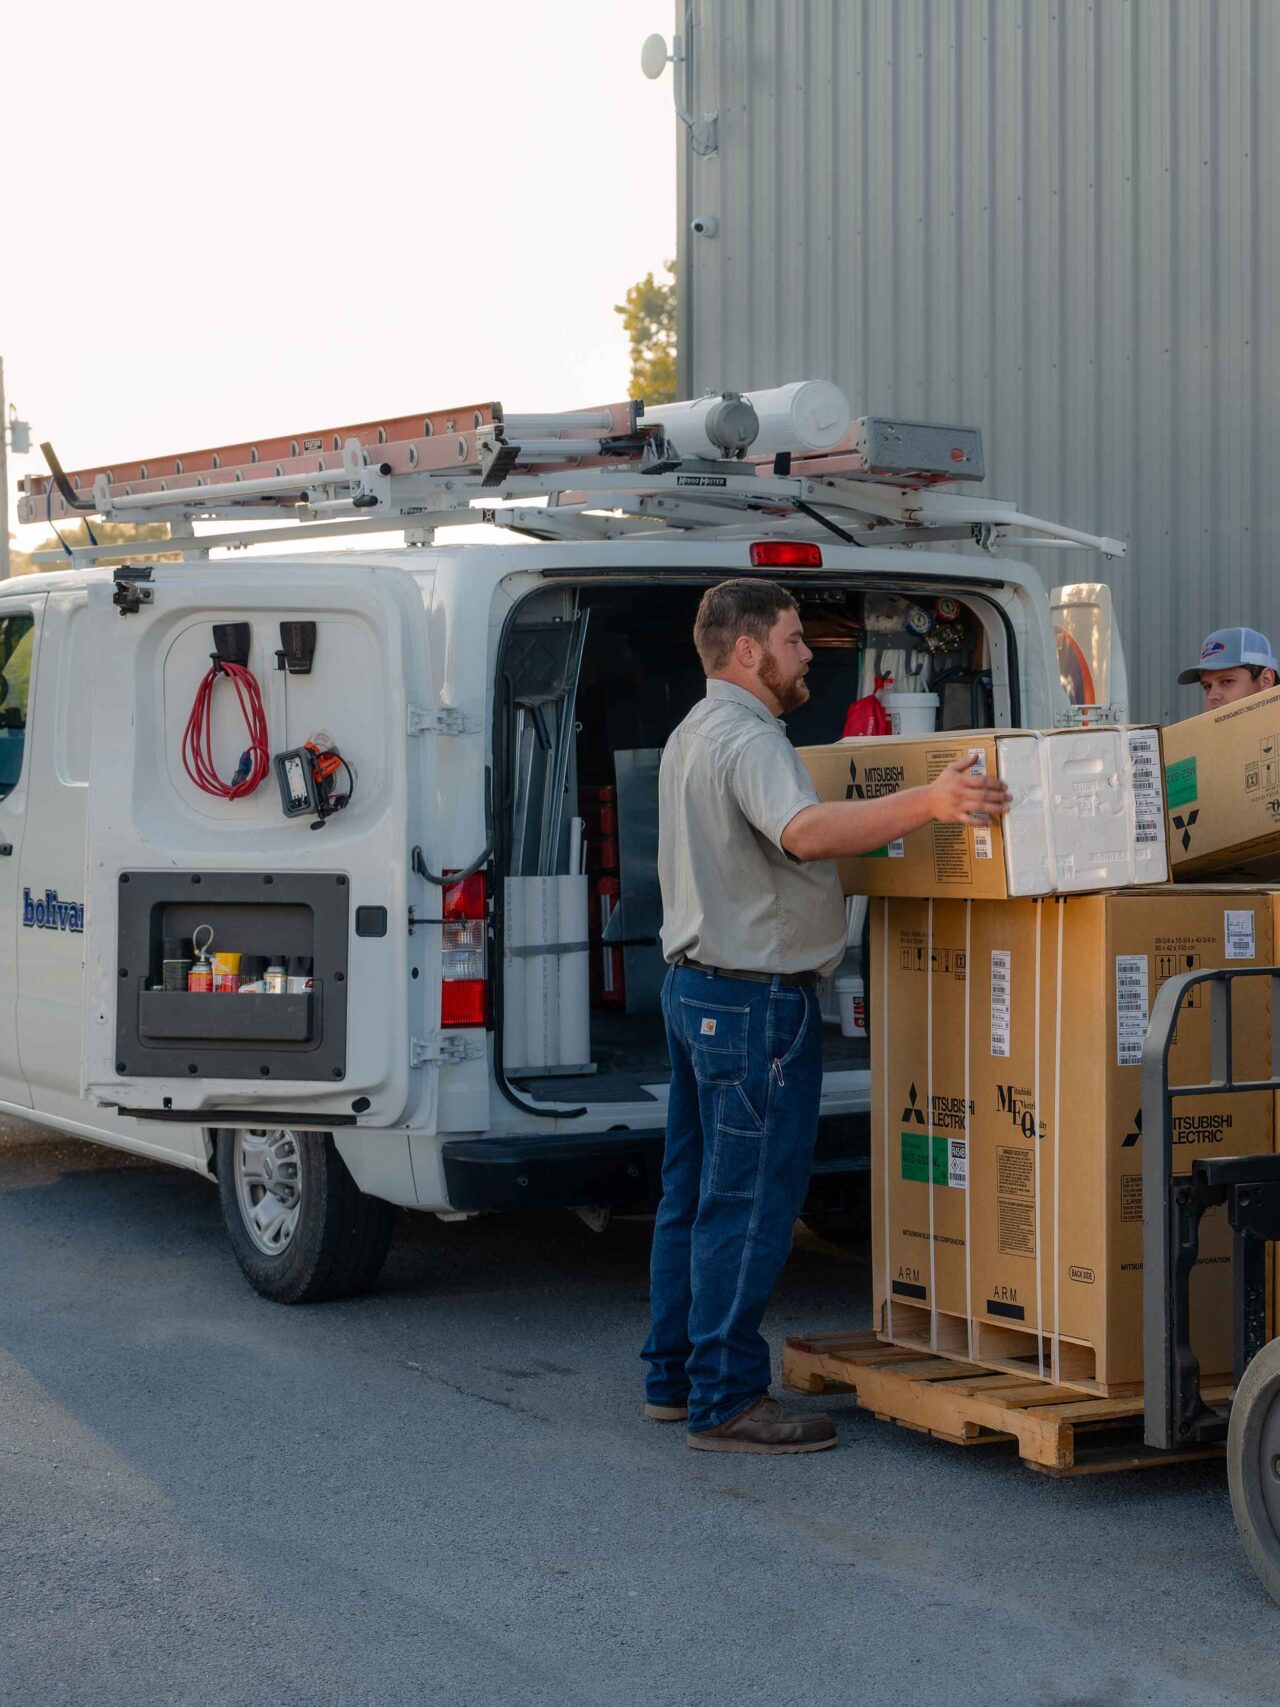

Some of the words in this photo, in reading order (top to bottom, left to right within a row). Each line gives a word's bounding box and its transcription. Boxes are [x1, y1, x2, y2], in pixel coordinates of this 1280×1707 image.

[864, 766, 905, 783] MITSUBISHI
[1172, 1114, 1232, 1130] ITSUBISHI
[1172, 1130, 1223, 1145] LECTRIC
[898, 1266, 920, 1282] ARM
[1071, 1269, 1082, 1279] BACK
[1083, 1270, 1093, 1281] SIDE
[993, 1285, 1017, 1302] ARM
